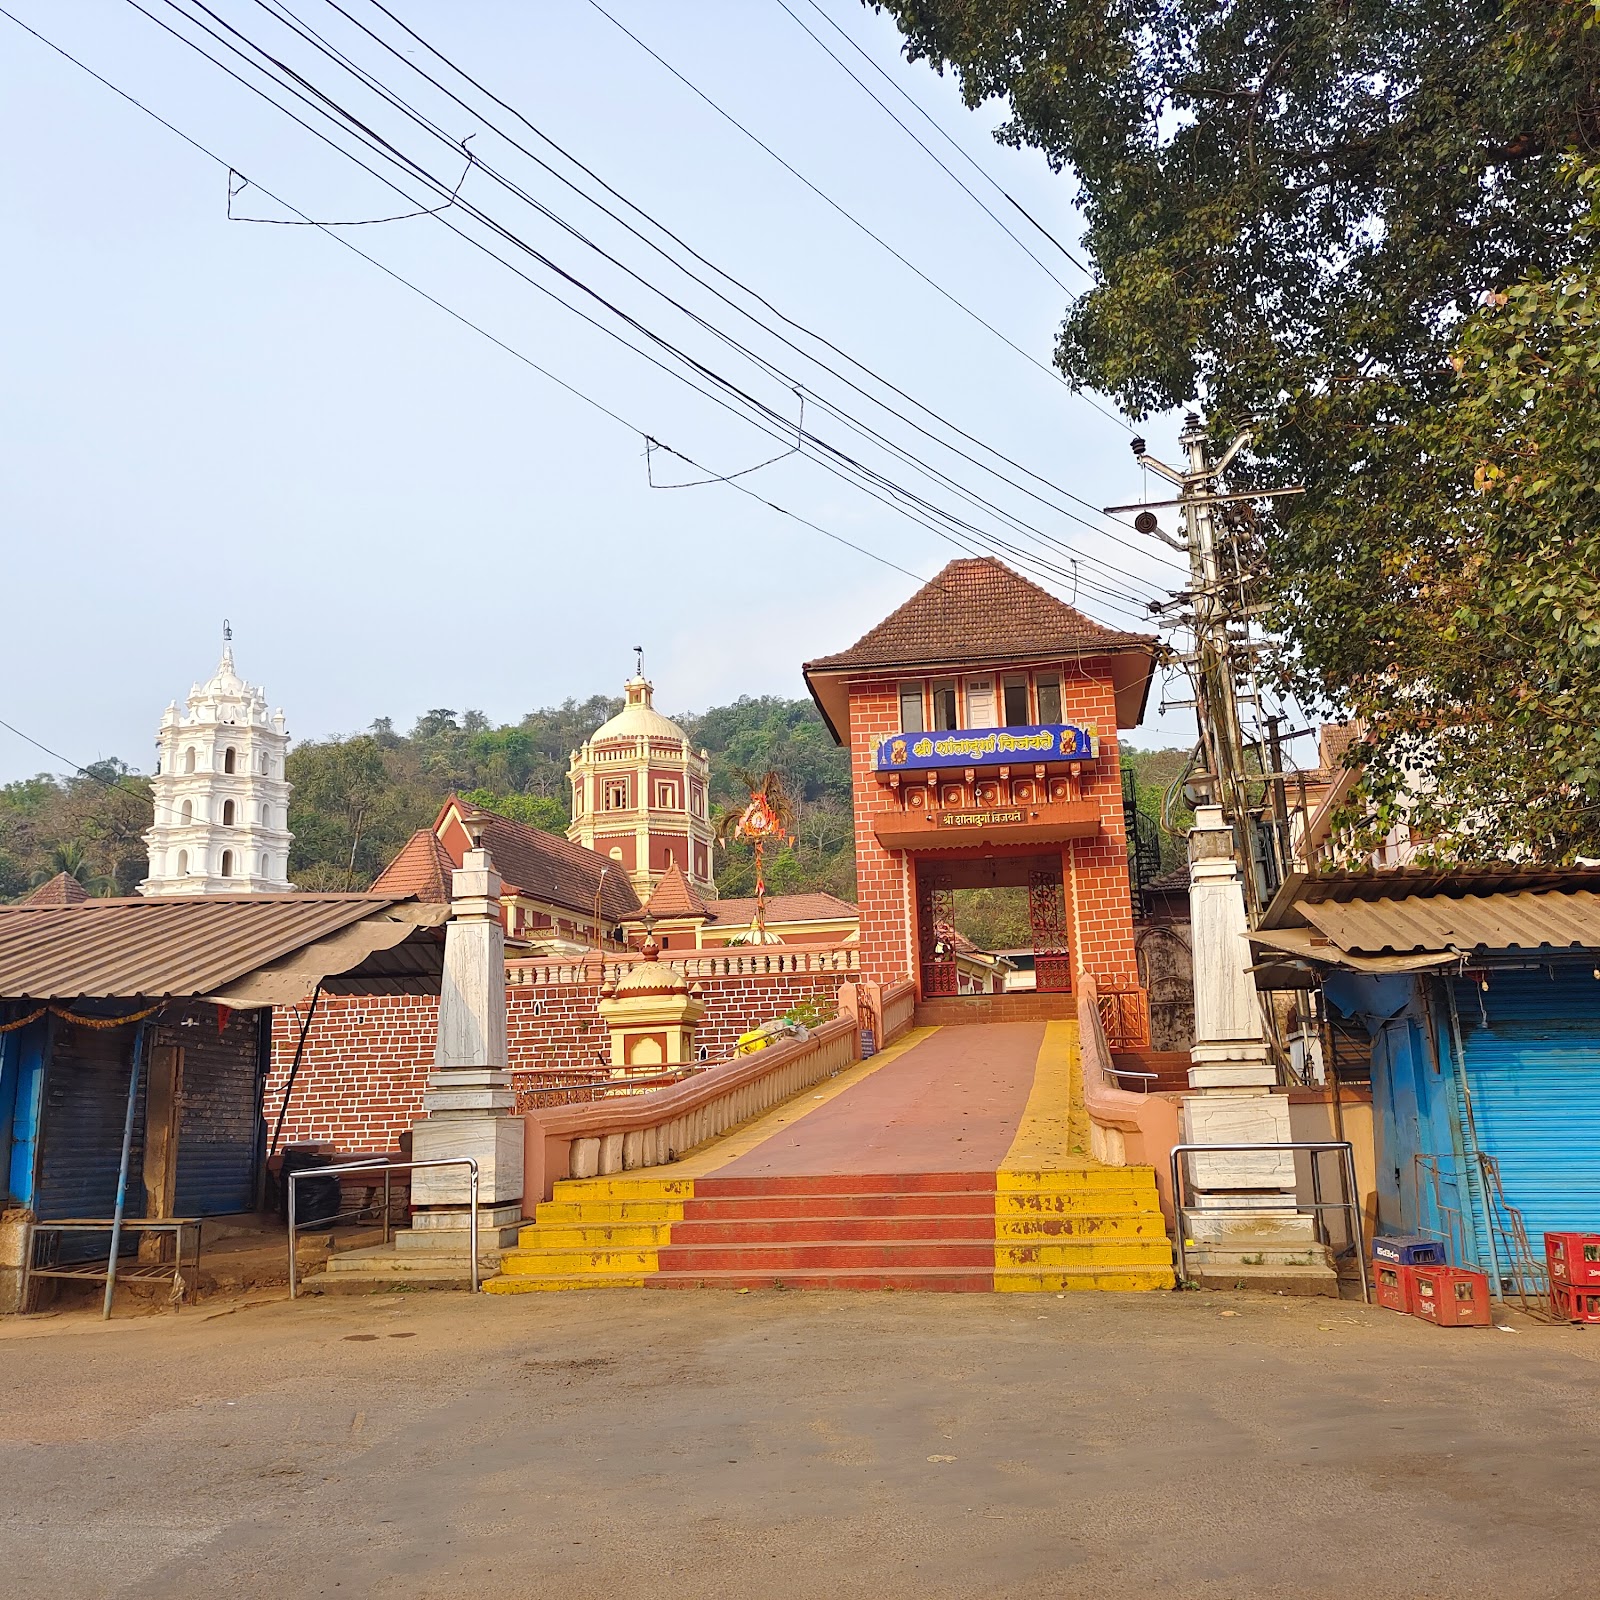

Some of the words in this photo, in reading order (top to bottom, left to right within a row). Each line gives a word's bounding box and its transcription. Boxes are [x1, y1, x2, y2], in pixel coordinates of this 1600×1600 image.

[913, 737, 932, 757] श्री
[935, 734, 996, 758] शांतादुर्गा
[998, 731, 1054, 751] विजयते
[943, 813, 953, 825] श्री
